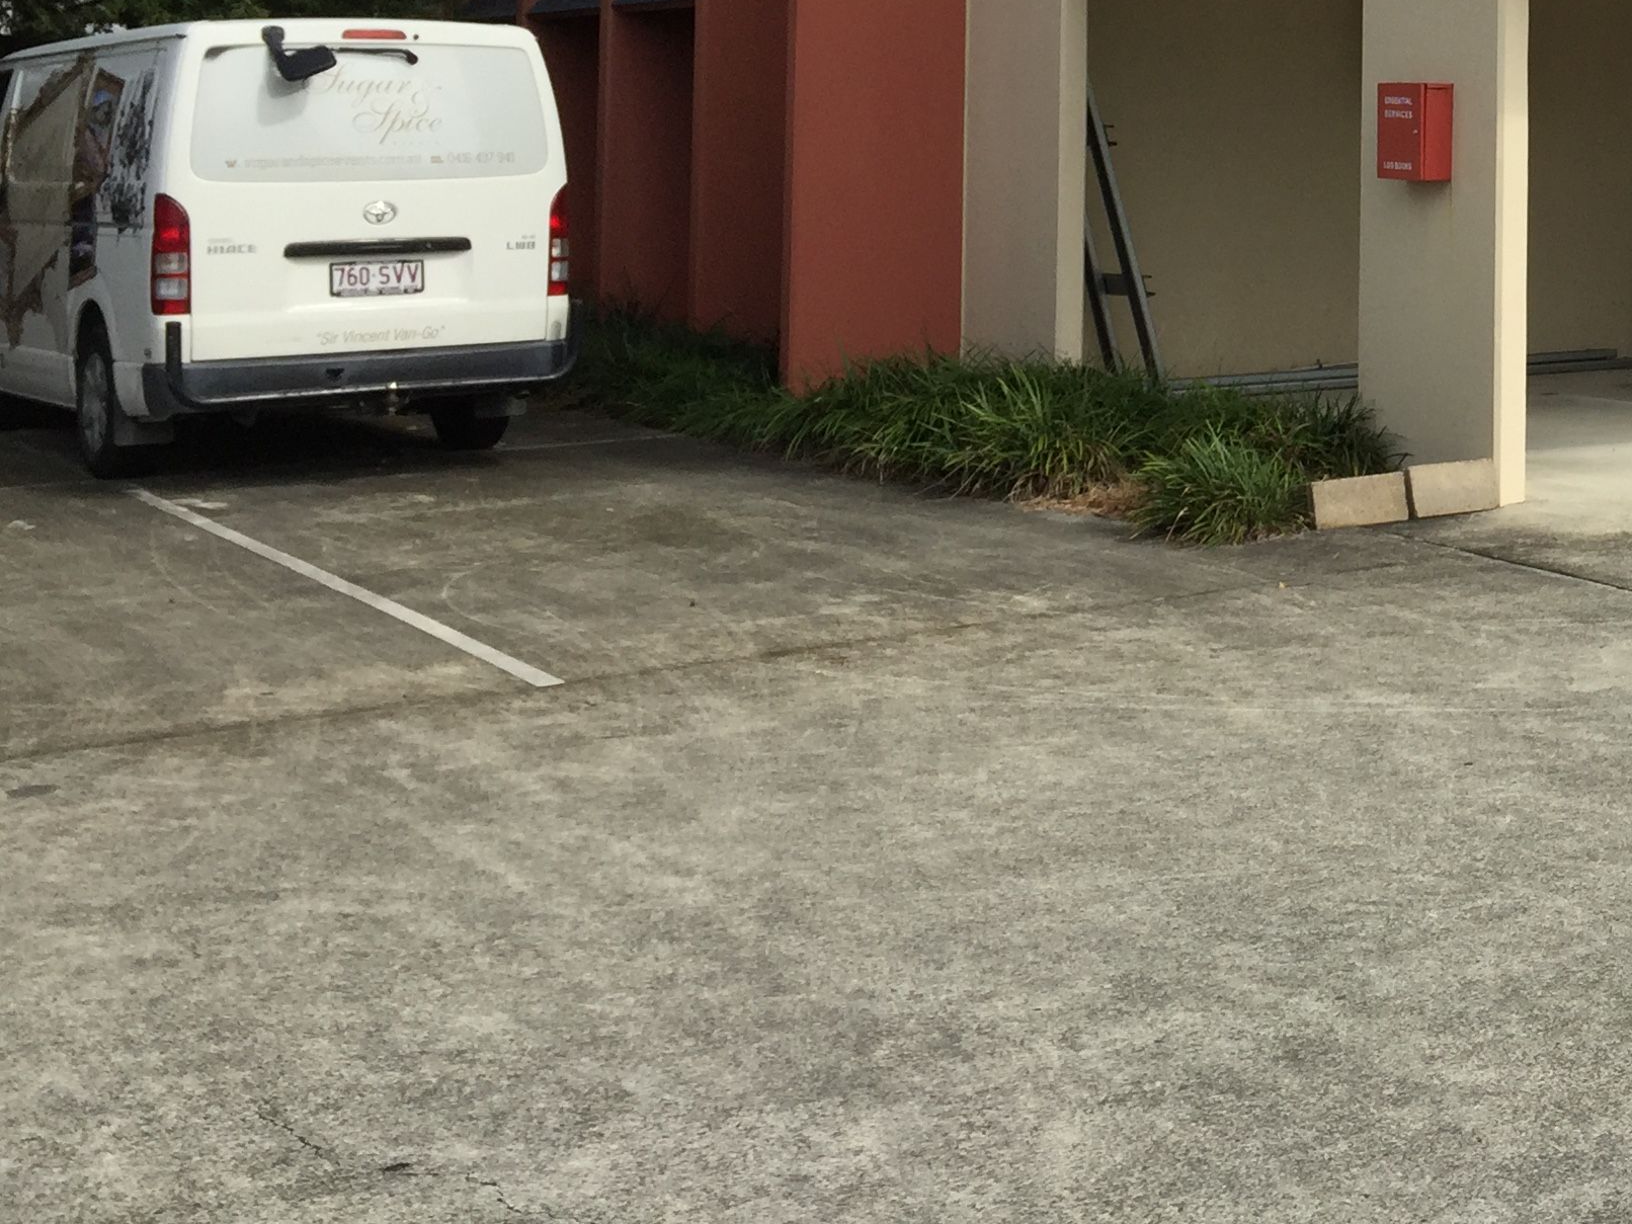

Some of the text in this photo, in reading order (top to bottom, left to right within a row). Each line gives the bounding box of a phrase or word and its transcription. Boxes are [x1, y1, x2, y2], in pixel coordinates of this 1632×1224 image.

[308, 62, 411, 108] Sugar
[352, 95, 443, 145] Spice
[334, 263, 419, 287] 760 SVV
[343, 329, 389, 344] Vincent
